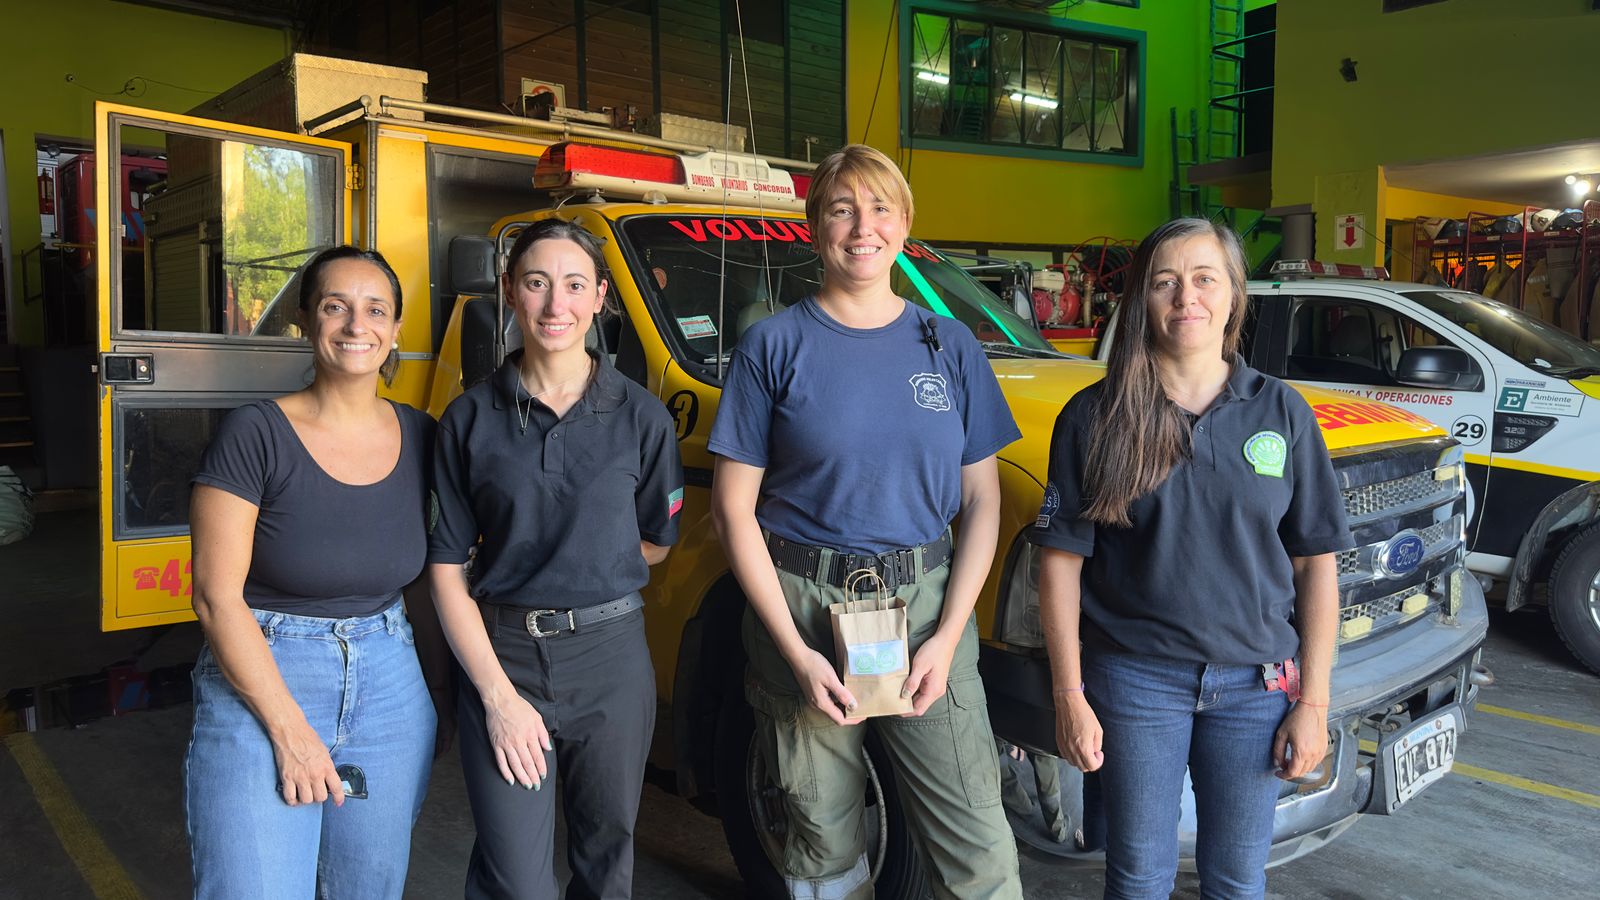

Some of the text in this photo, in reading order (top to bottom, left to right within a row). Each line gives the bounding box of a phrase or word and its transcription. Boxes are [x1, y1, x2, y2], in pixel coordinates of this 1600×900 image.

[753, 182, 792, 194] CONCORDIA
[1375, 391, 1453, 406] OPERACIONES
[1533, 393, 1572, 404] Ambiente
[1454, 421, 1484, 438] 29
[1396, 541, 1420, 567] Ford
